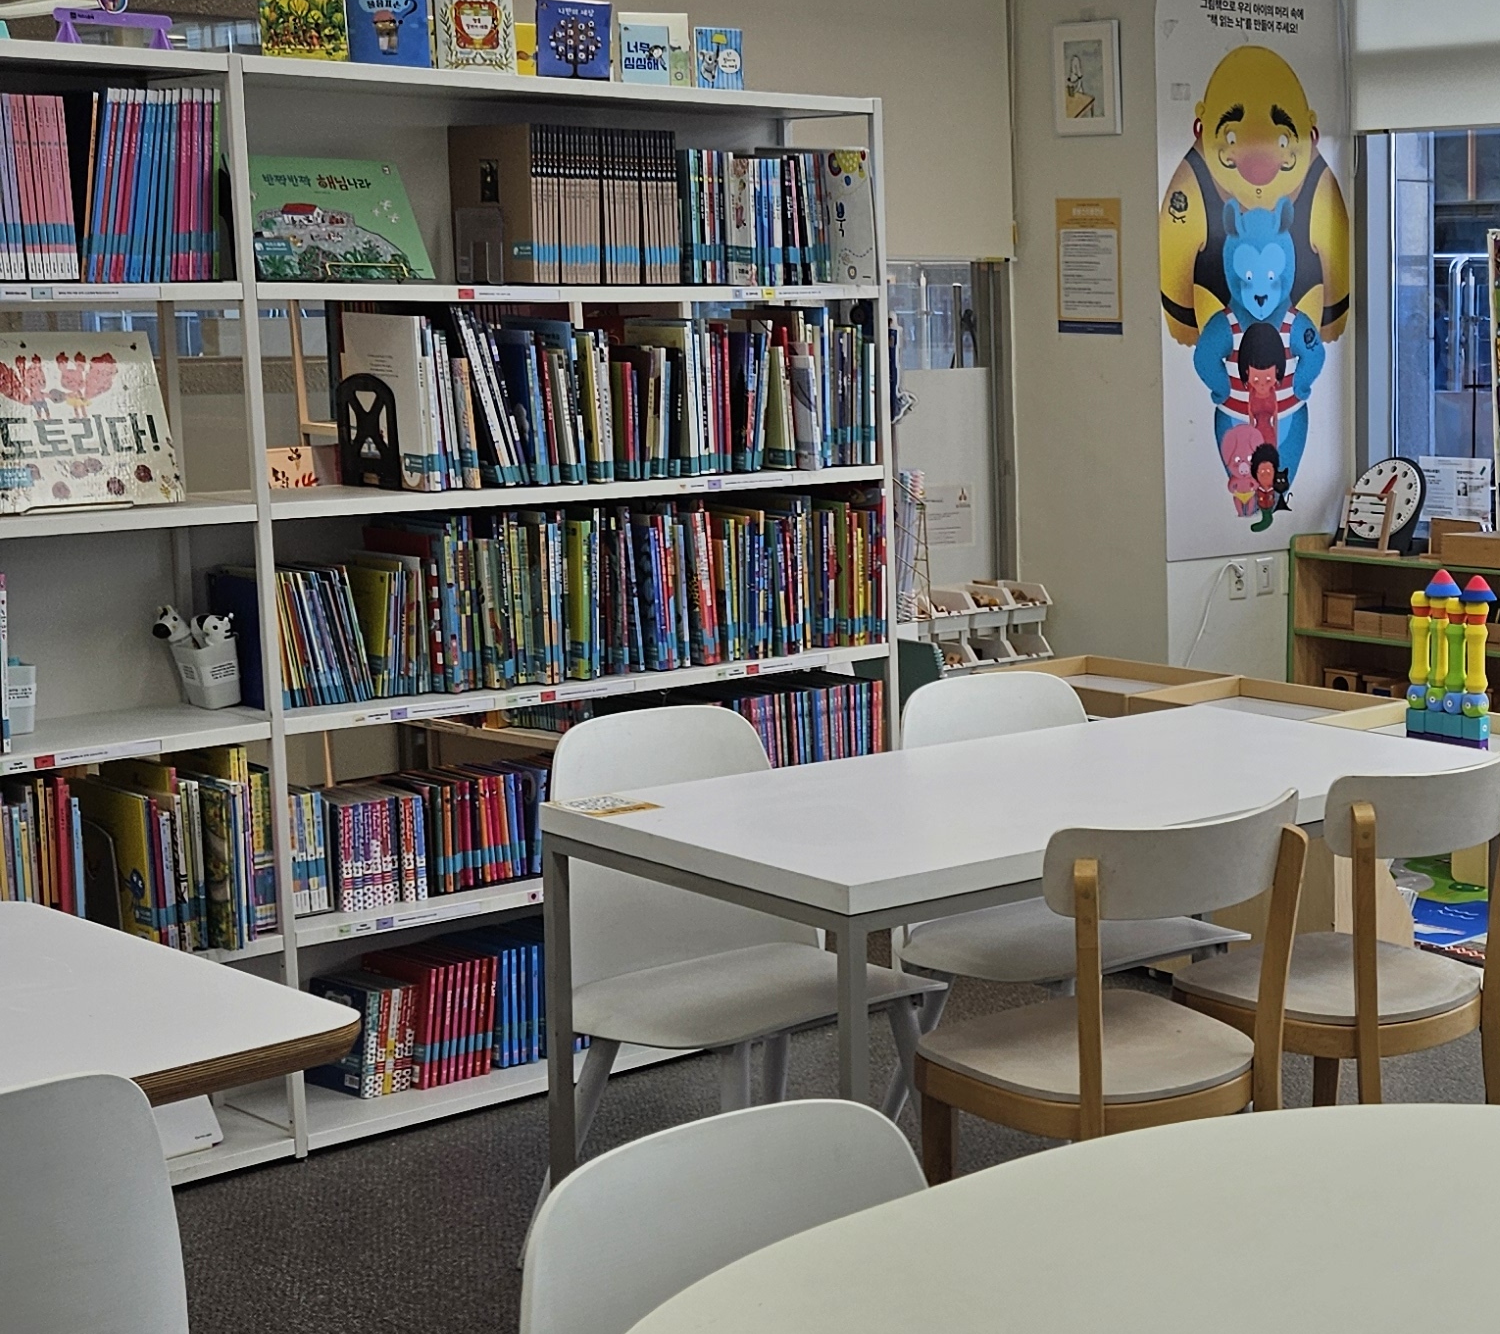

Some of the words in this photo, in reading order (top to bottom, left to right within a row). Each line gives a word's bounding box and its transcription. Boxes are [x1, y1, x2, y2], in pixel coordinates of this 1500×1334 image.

[1238, 2, 1252, 14] 우리
[1253, 4, 1274, 18] 아이의
[1275, 6, 1289, 19] 머리
[1290, 7, 1304, 20] 속에
[1219, 16, 1235, 28] 읽는
[1254, 19, 1275, 33] 만들어
[1276, 21, 1299, 34] 주세요!
[624, 56, 660, 72] 심심해
[262, 173, 312, 187] 반짝반짝
[316, 174, 372, 191] 해님나라
